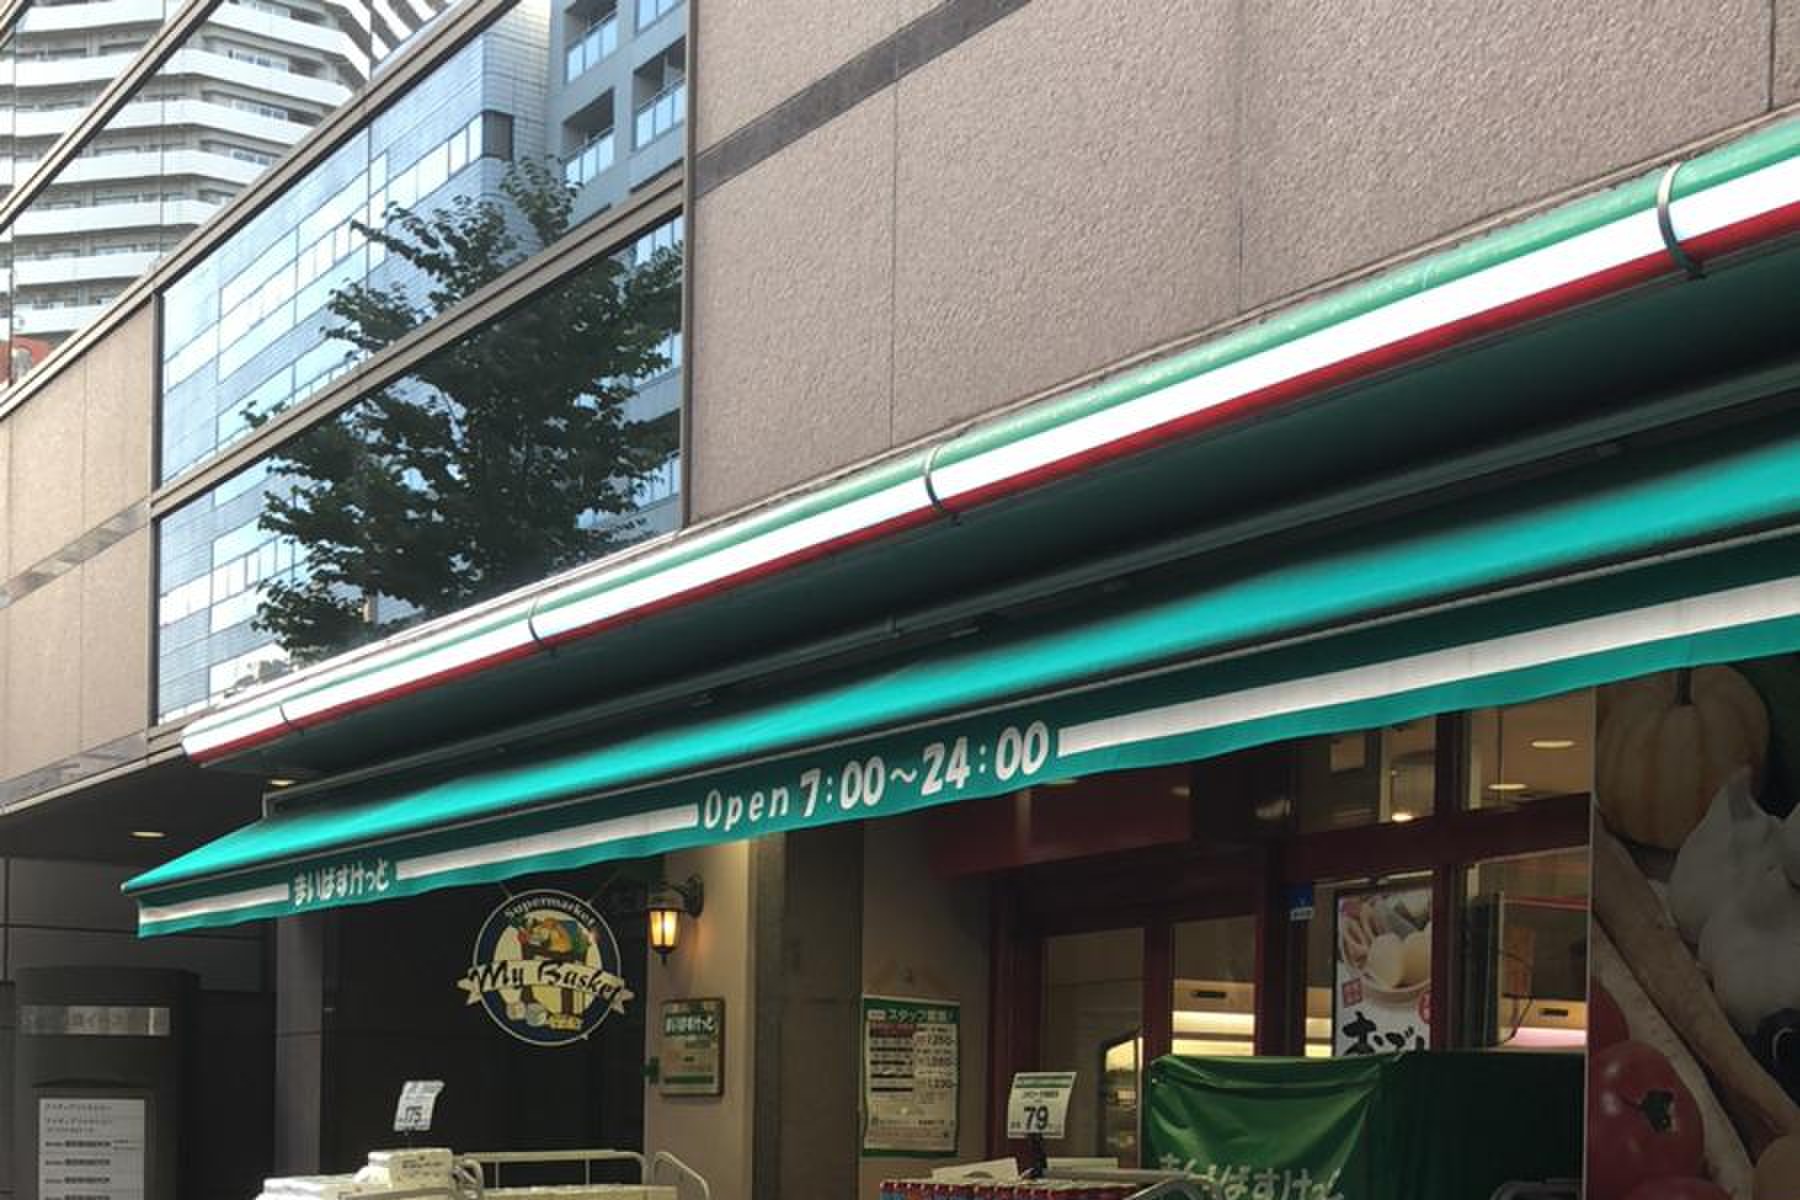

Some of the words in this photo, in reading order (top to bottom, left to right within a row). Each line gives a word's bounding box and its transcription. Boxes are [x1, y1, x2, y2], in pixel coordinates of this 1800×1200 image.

[703, 789, 790, 831] Open
[294, 857, 391, 907] まいばすけっと
[504, 896, 598, 928] Supermarket
[470, 960, 525, 992] My
[537, 960, 623, 1000] Basket
[1023, 1105, 1050, 1131] 79
